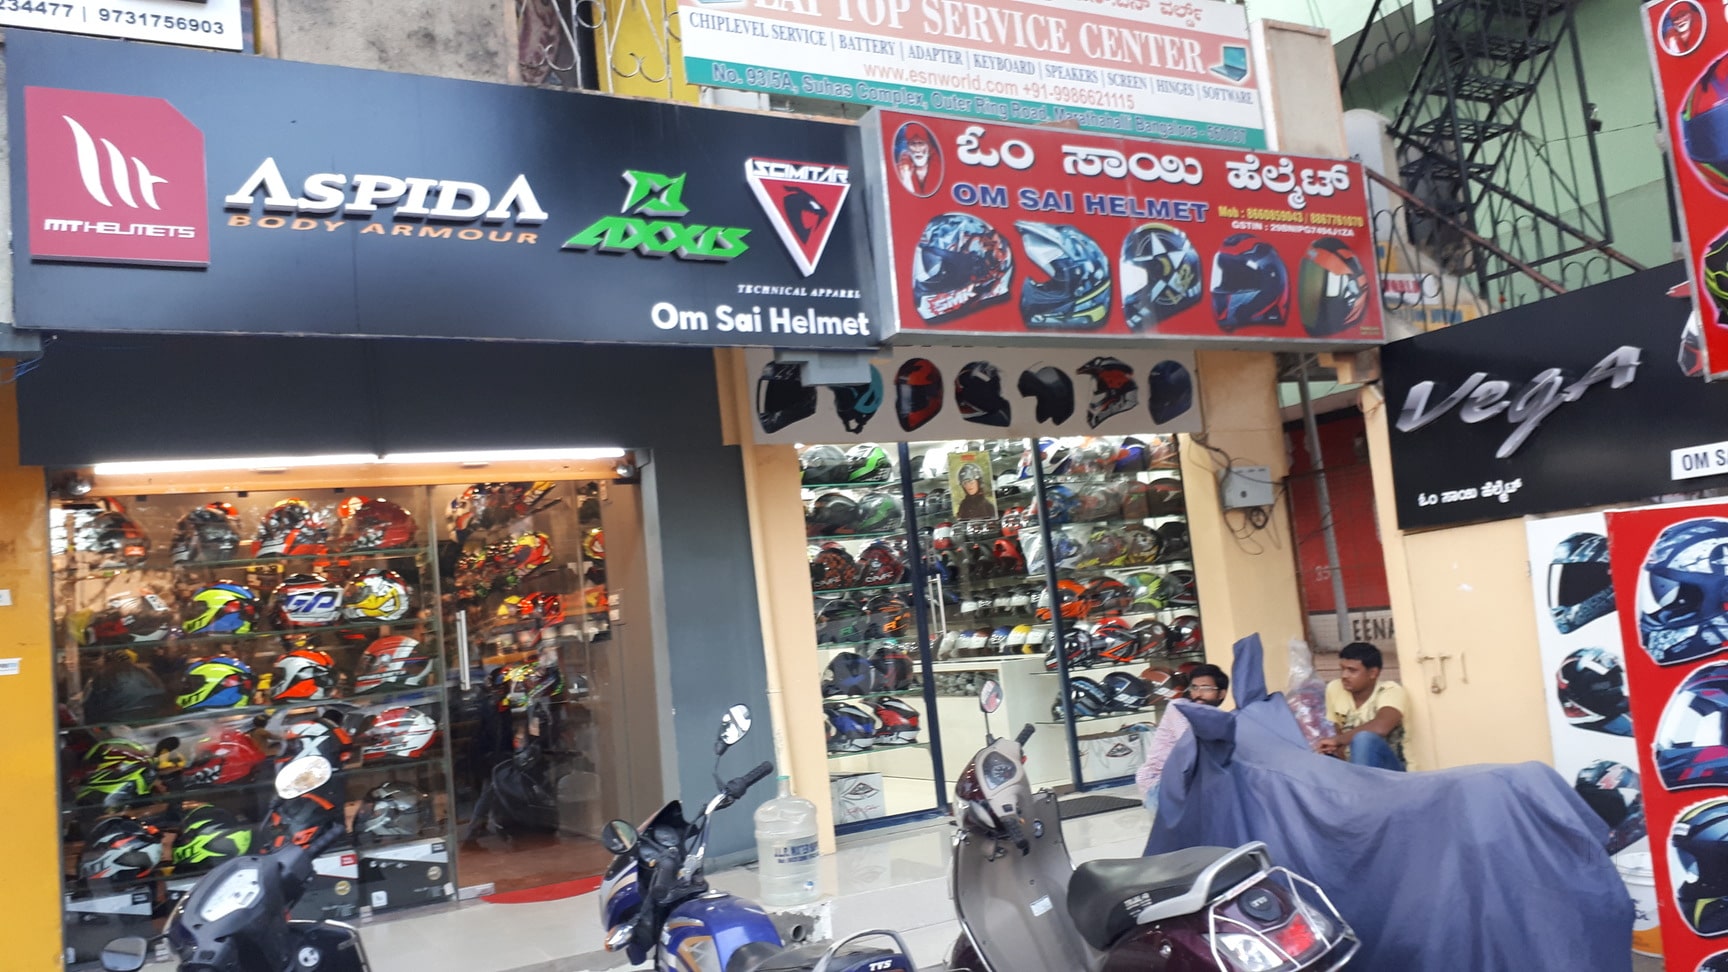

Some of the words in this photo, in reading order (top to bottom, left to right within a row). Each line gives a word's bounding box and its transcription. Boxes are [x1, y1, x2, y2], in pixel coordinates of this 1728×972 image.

[98, 8, 225, 35] 9731756903
[755, 0, 911, 28] TOP
[922, 0, 1071, 54] SERVICE
[1079, 21, 1208, 74] CENTER
[689, 12, 769, 38] CHIPLEVEL
[771, 24, 827, 47] SERVICE
[839, 34, 896, 56] BATTERY
[908, 44, 963, 66] ADAPTER
[973, 53, 1036, 76] KEYBOARD
[1045, 63, 1099, 84] SPEAKERS
[1107, 72, 1148, 90] SCREEN
[1156, 79, 1195, 97] HINGES
[1202, 86, 1254, 105] SOFTWARE
[712, 63, 742, 84] No.
[802, 75, 852, 98] Suhas
[857, 82, 929, 111] Complex,
[930, 91, 972, 113] Outer
[974, 97, 1009, 120] Ring
[1135, 115, 1199, 139] Bangalore
[864, 63, 1019, 96] www.esnworld.com
[1022, 81, 1136, 110] +91-9986621115
[751, 159, 850, 184] SCIMITAR
[956, 125, 1036, 170] ಓಂ
[1061, 144, 1203, 186] ಸಾಯಿ
[224, 157, 549, 224] ASPIDA
[952, 183, 1010, 209] OM
[1018, 188, 1074, 214] SAI
[1084, 193, 1209, 224] HELMET
[226, 214, 347, 233] BODY
[360, 222, 539, 245] ARMOUR
[560, 215, 753, 260] AXXIS
[737, 283, 808, 297] TECHNICAL
[810, 287, 862, 299] APPAREL
[651, 301, 709, 331] Om
[715, 304, 763, 333] Sai
[768, 306, 871, 336] Helmet
[1682, 451, 1710, 472] OM
[1714, 448, 1728, 467] S
[868, 959, 893, 971] TVS
